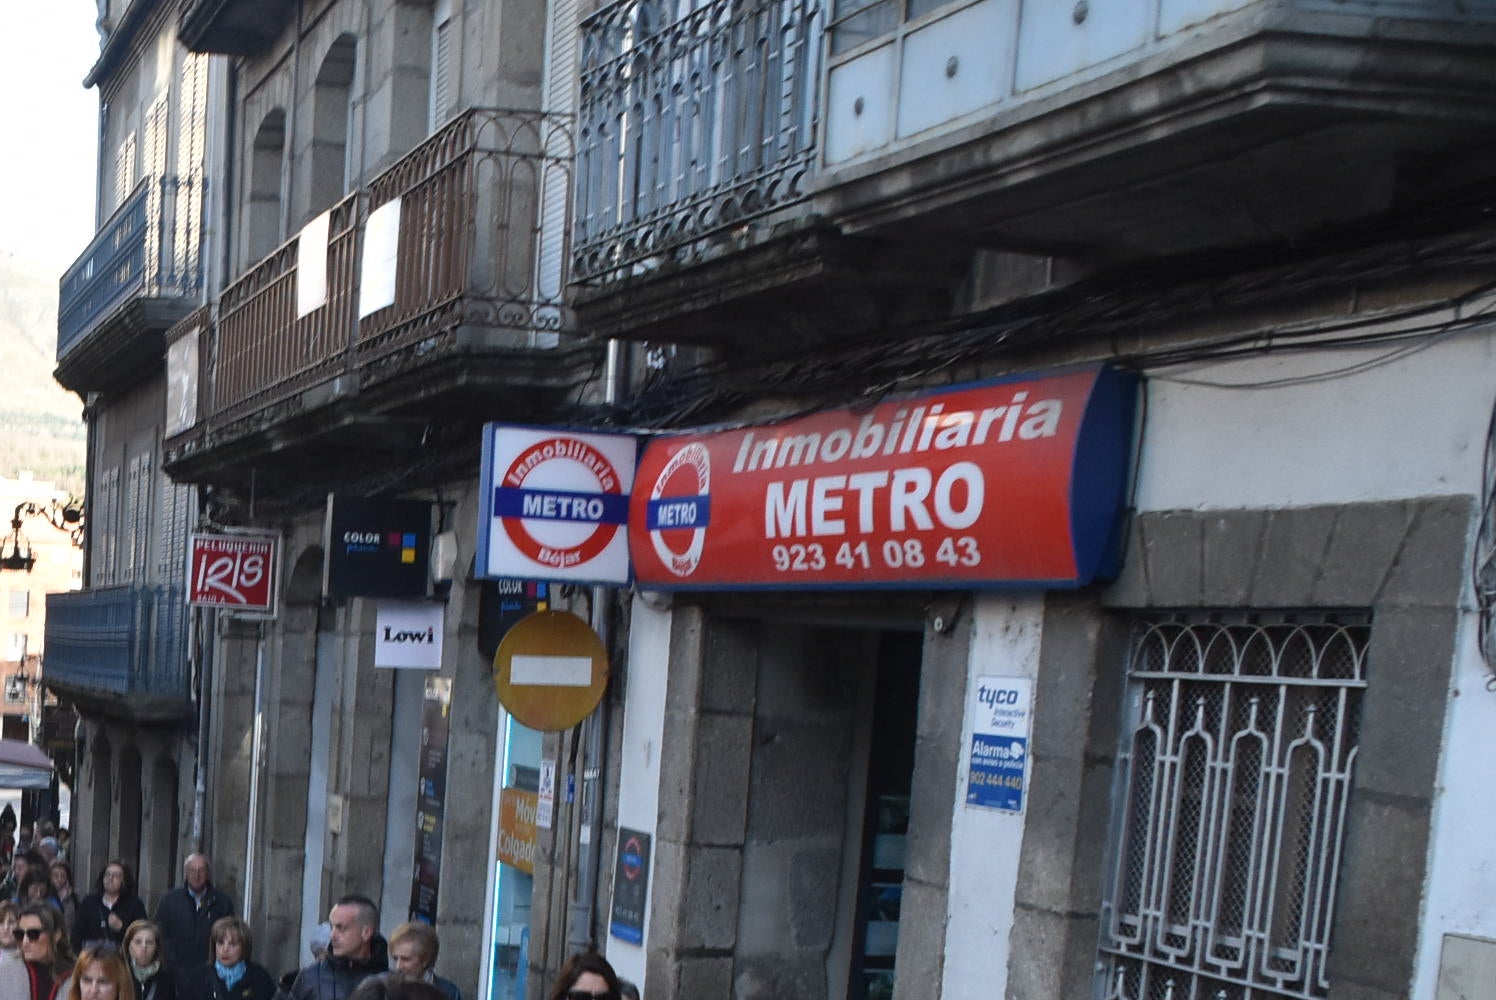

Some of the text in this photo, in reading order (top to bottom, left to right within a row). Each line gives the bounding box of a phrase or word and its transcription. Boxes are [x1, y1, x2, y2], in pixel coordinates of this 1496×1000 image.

[732, 391, 1063, 474] Inmobiliaria
[508, 440, 615, 491] Inmobiliaria
[522, 493, 604, 521] METRO
[765, 461, 985, 539] METRO
[657, 501, 697, 526] METRO
[344, 531, 380, 545] COLOR
[537, 547, 581, 569] Béjar
[772, 536, 981, 572] 923 41 08 43
[196, 552, 264, 605] IRIS
[384, 625, 434, 643] Lowi
[978, 684, 1019, 710] tyco
[973, 740, 1010, 759] Alarma
[986, 773, 1003, 787] 444
[1005, 775, 1023, 790] 440
